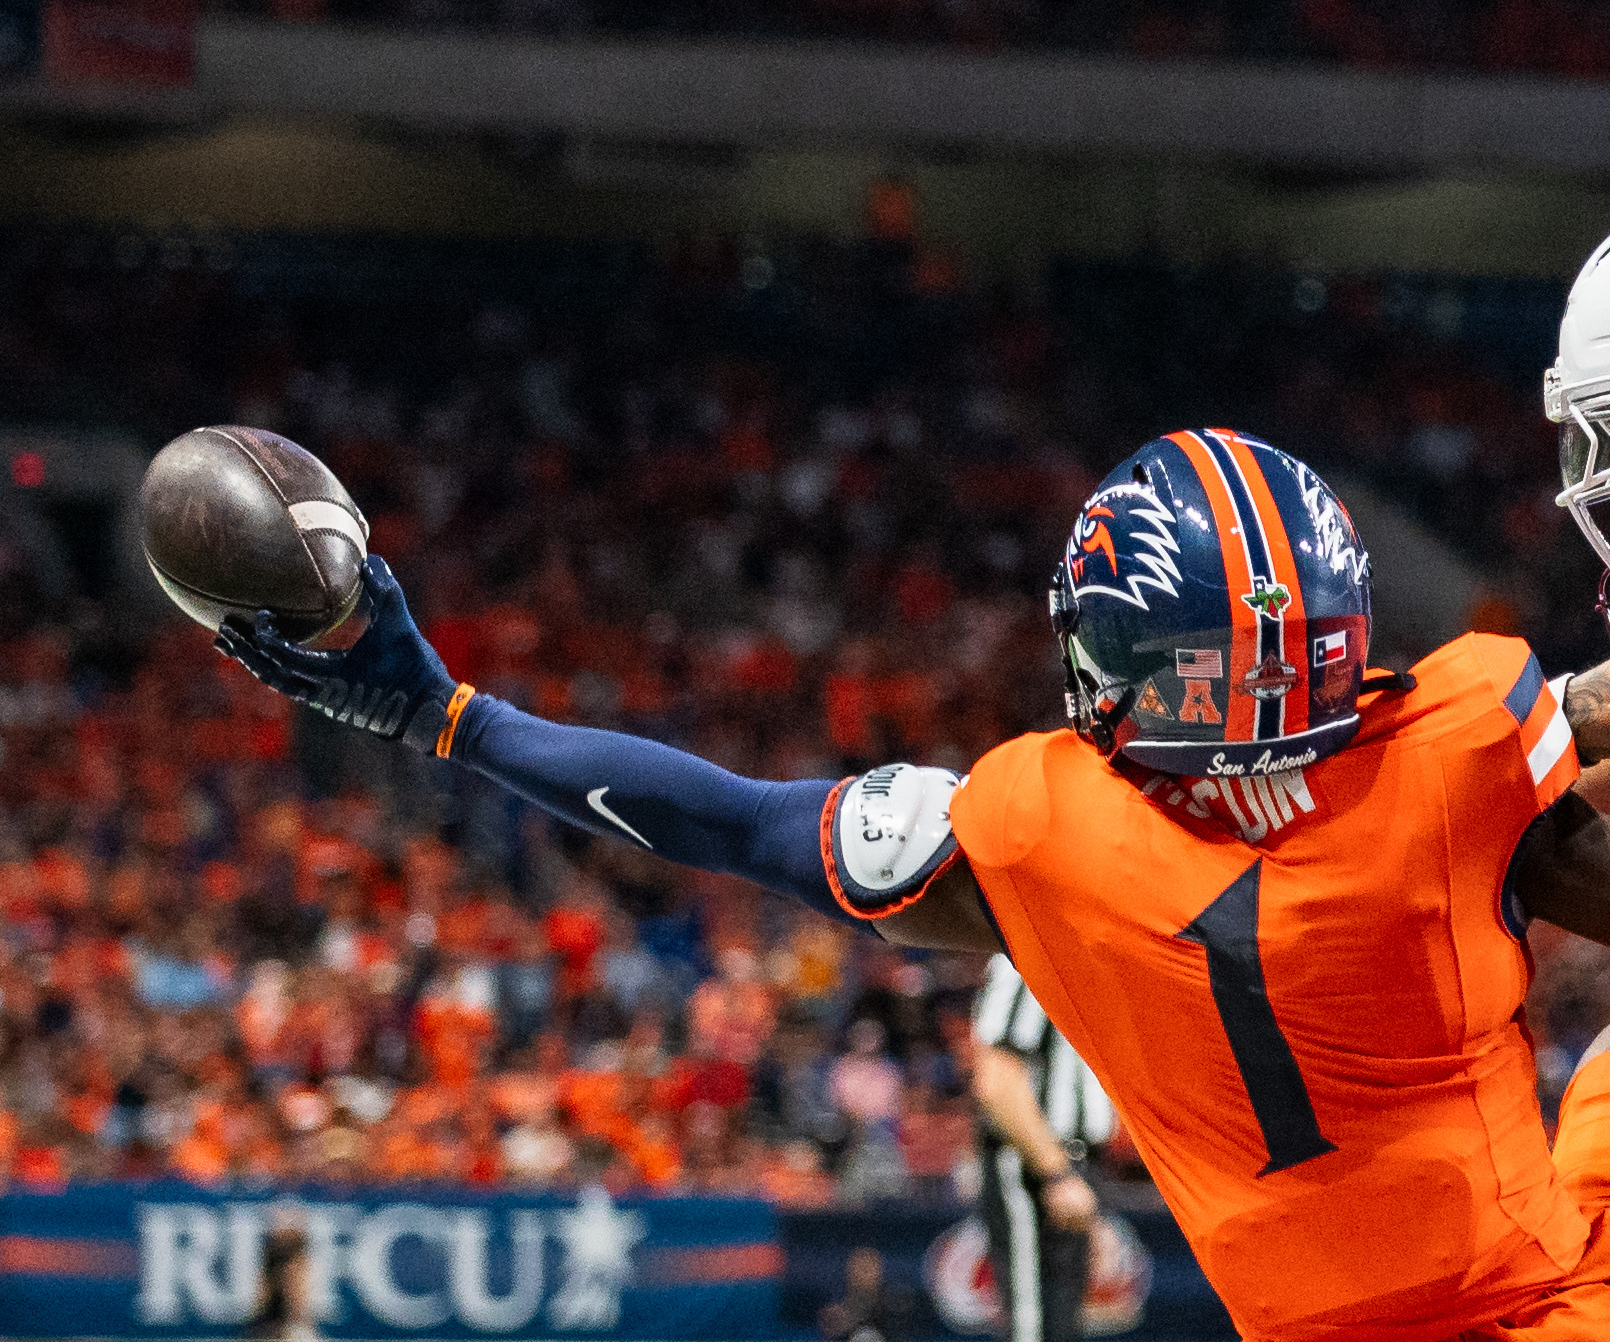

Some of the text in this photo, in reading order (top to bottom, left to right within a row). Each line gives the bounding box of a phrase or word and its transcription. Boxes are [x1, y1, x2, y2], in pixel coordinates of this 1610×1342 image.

[1207, 746, 1318, 776] San Antonio
[1174, 854, 1340, 1180] 1
